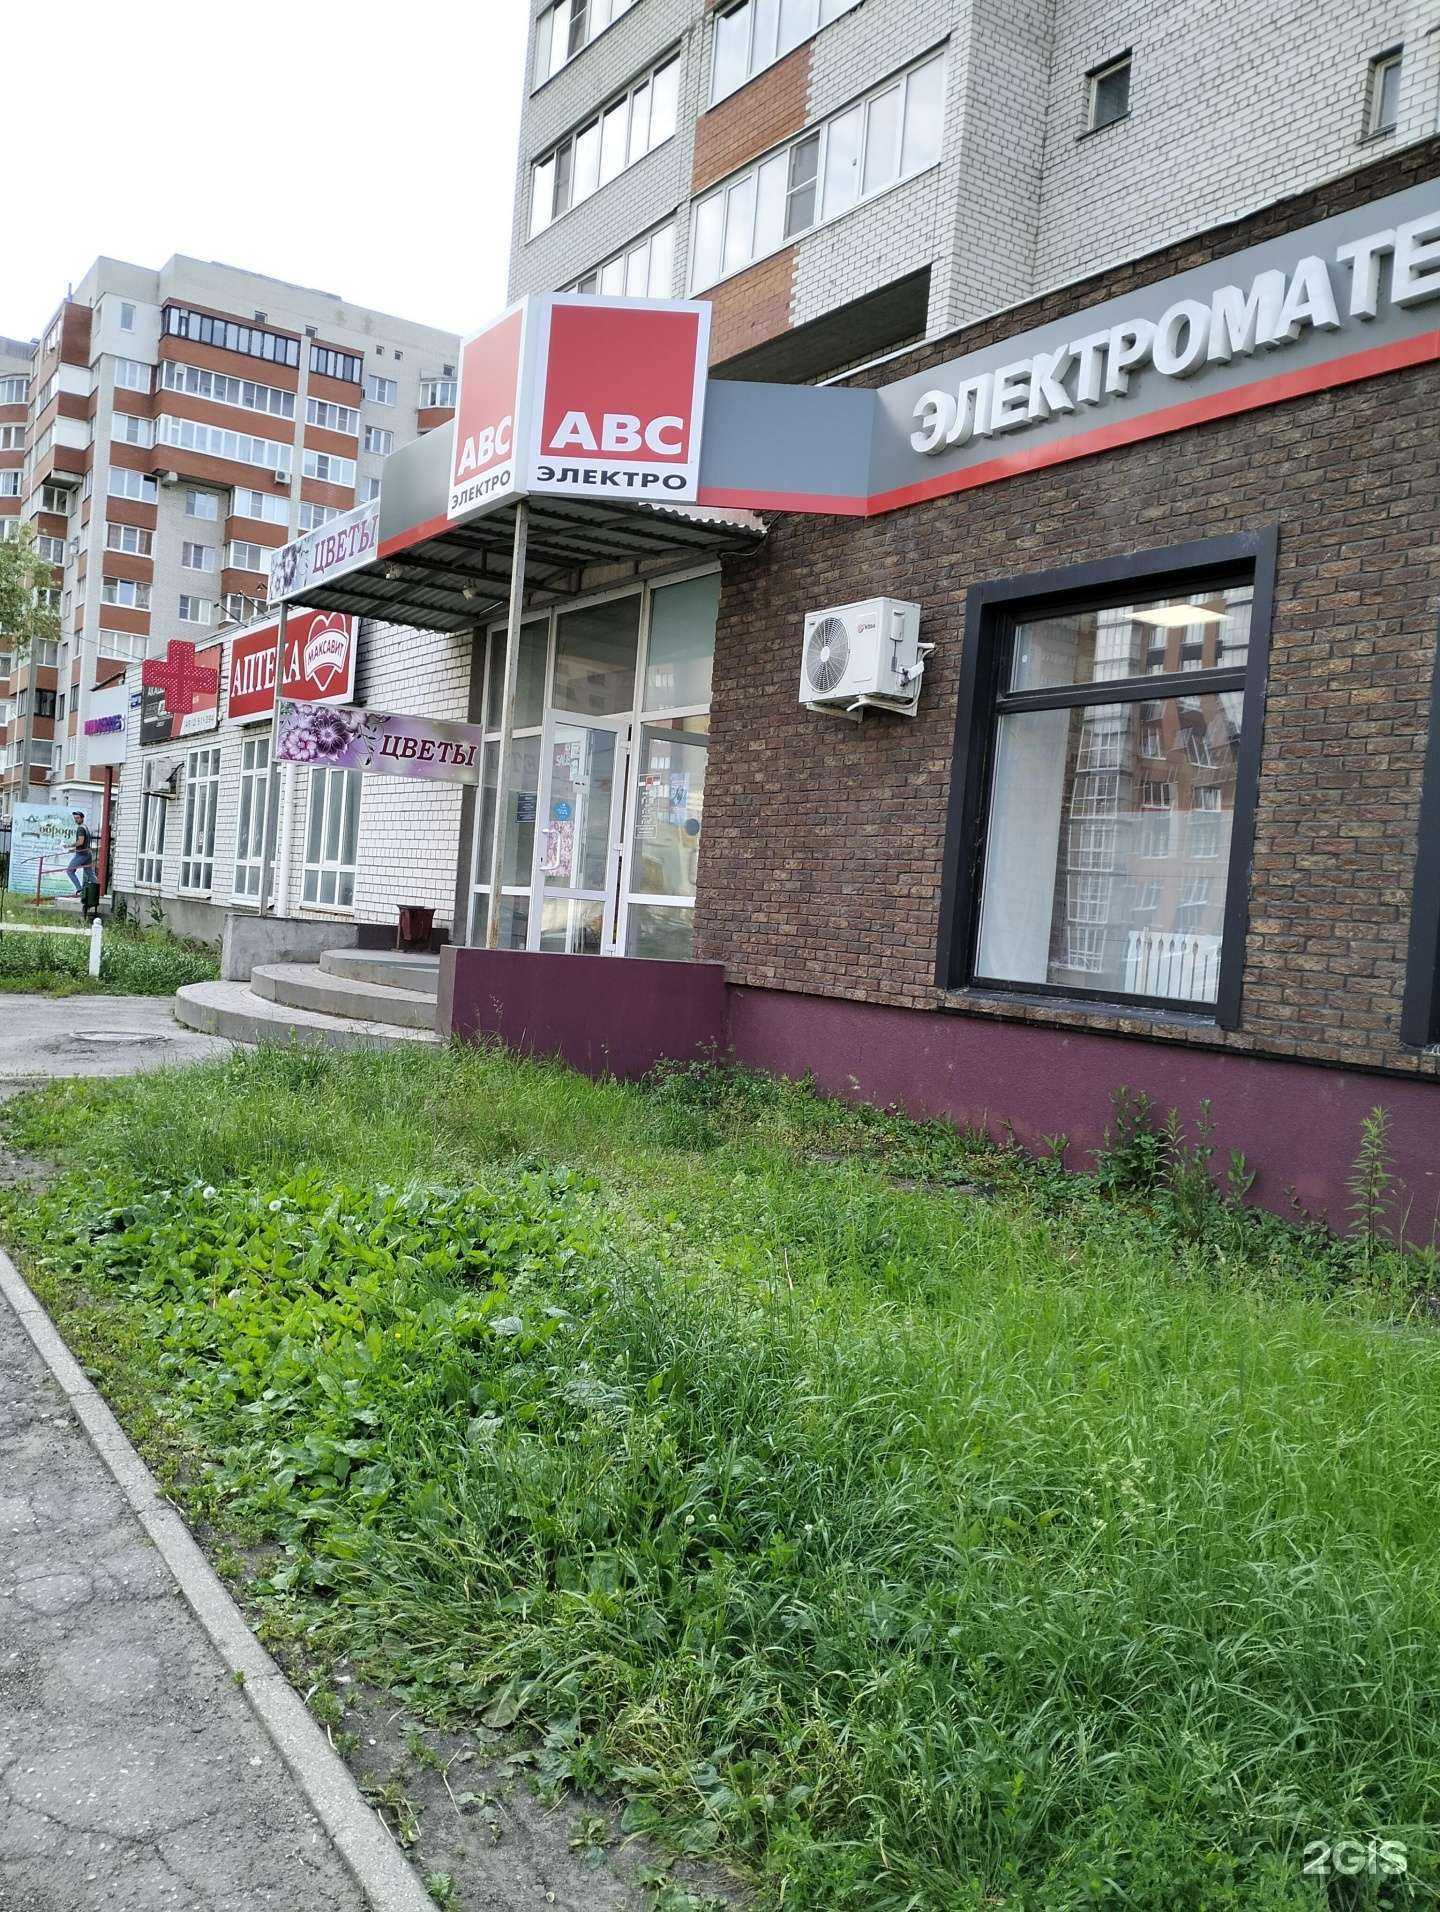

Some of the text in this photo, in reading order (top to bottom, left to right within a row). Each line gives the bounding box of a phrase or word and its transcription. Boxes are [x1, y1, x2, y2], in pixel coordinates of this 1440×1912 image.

[457, 415, 512, 477] АВС
[549, 410, 684, 455] АВС
[451, 469, 511, 510] ЭЛЕКТРО
[536, 465, 687, 490] ЭЛЕКТРО
[312, 514, 379, 574] ЦВЕТЫ
[307, 638, 344, 667] МАКСАВИТ
[380, 734, 478, 767] ЦВЕТЫ
